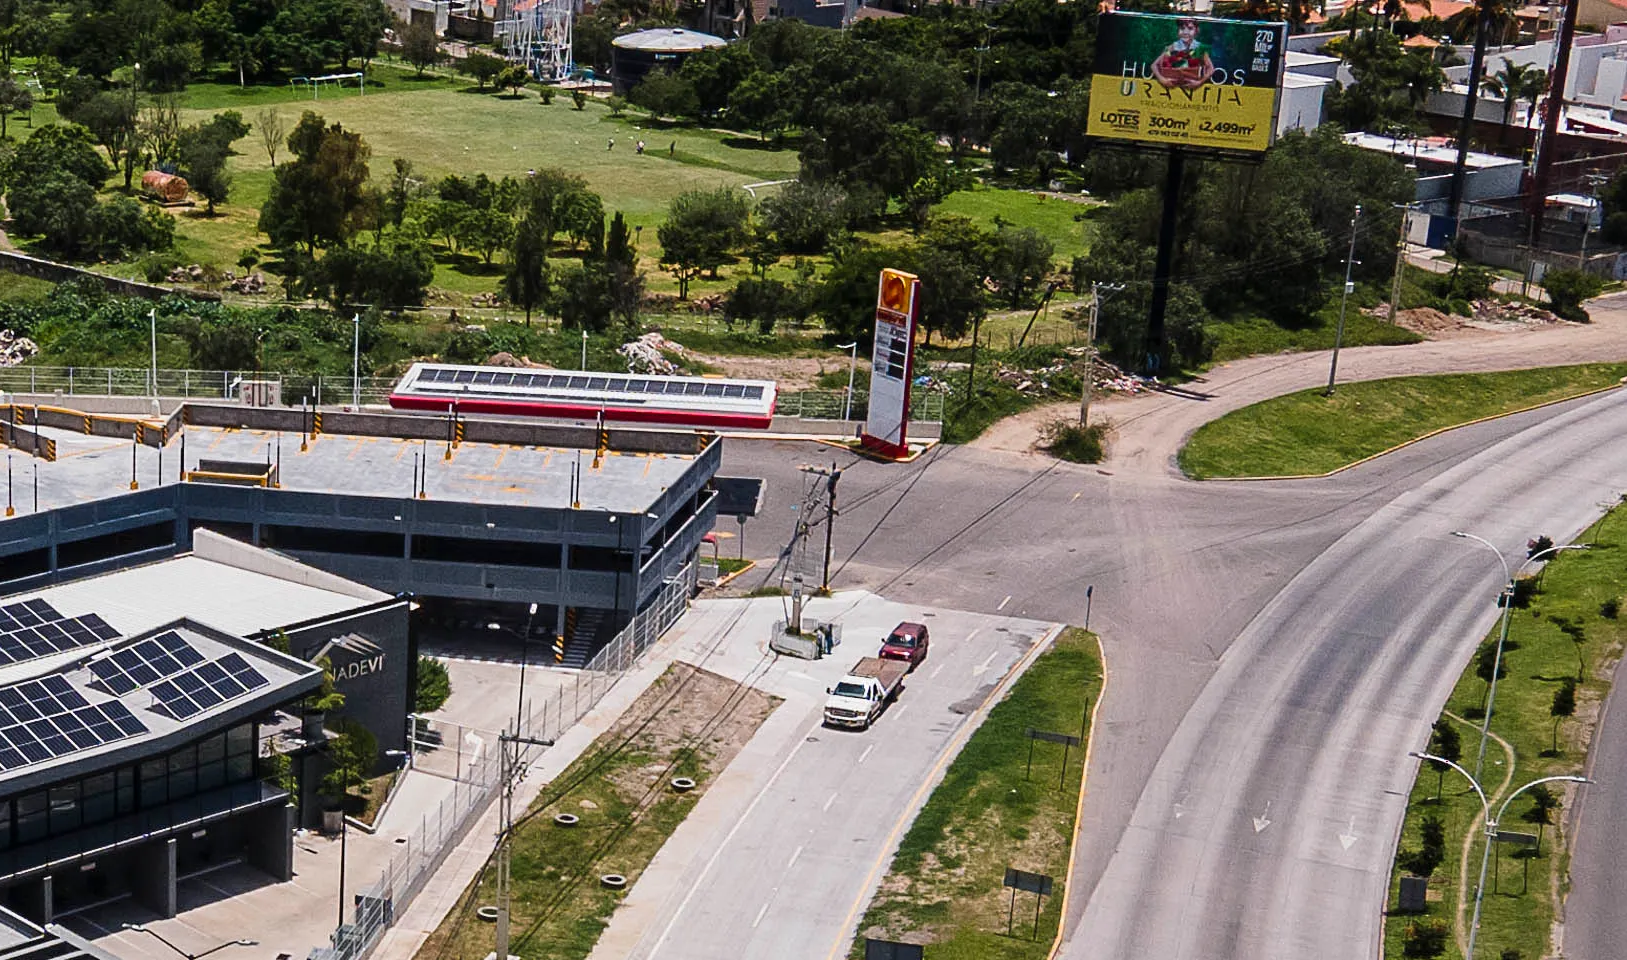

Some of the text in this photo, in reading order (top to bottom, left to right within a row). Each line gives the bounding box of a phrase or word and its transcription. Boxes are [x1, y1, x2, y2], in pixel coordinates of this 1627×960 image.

[1255, 30, 1273, 43] 270
[1122, 60, 1246, 87] HUOS
[1100, 111, 1140, 125] LOTES
